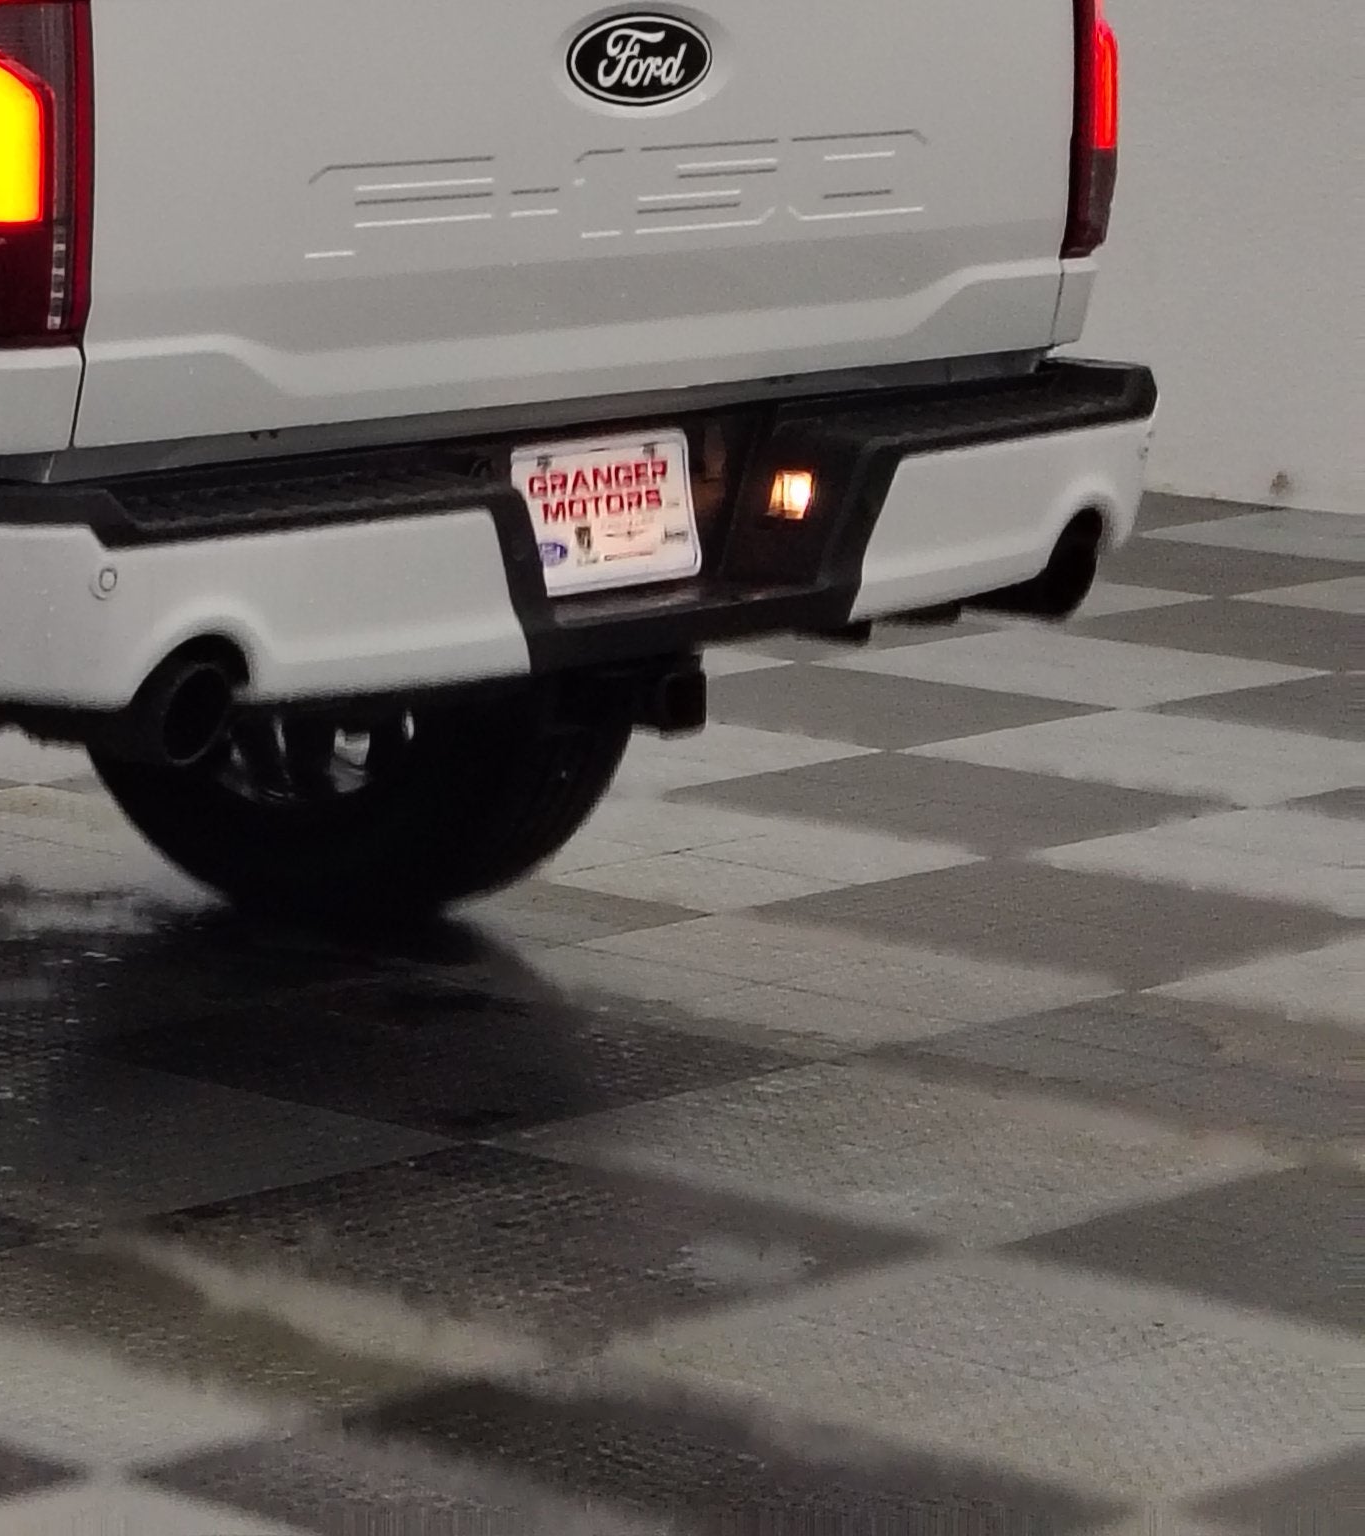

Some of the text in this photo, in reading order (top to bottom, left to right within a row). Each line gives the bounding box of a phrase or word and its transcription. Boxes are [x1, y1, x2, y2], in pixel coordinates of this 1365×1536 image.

[597, 28, 687, 87] Ford
[528, 459, 668, 498] GRANGER
[542, 489, 662, 524] MOTORS
